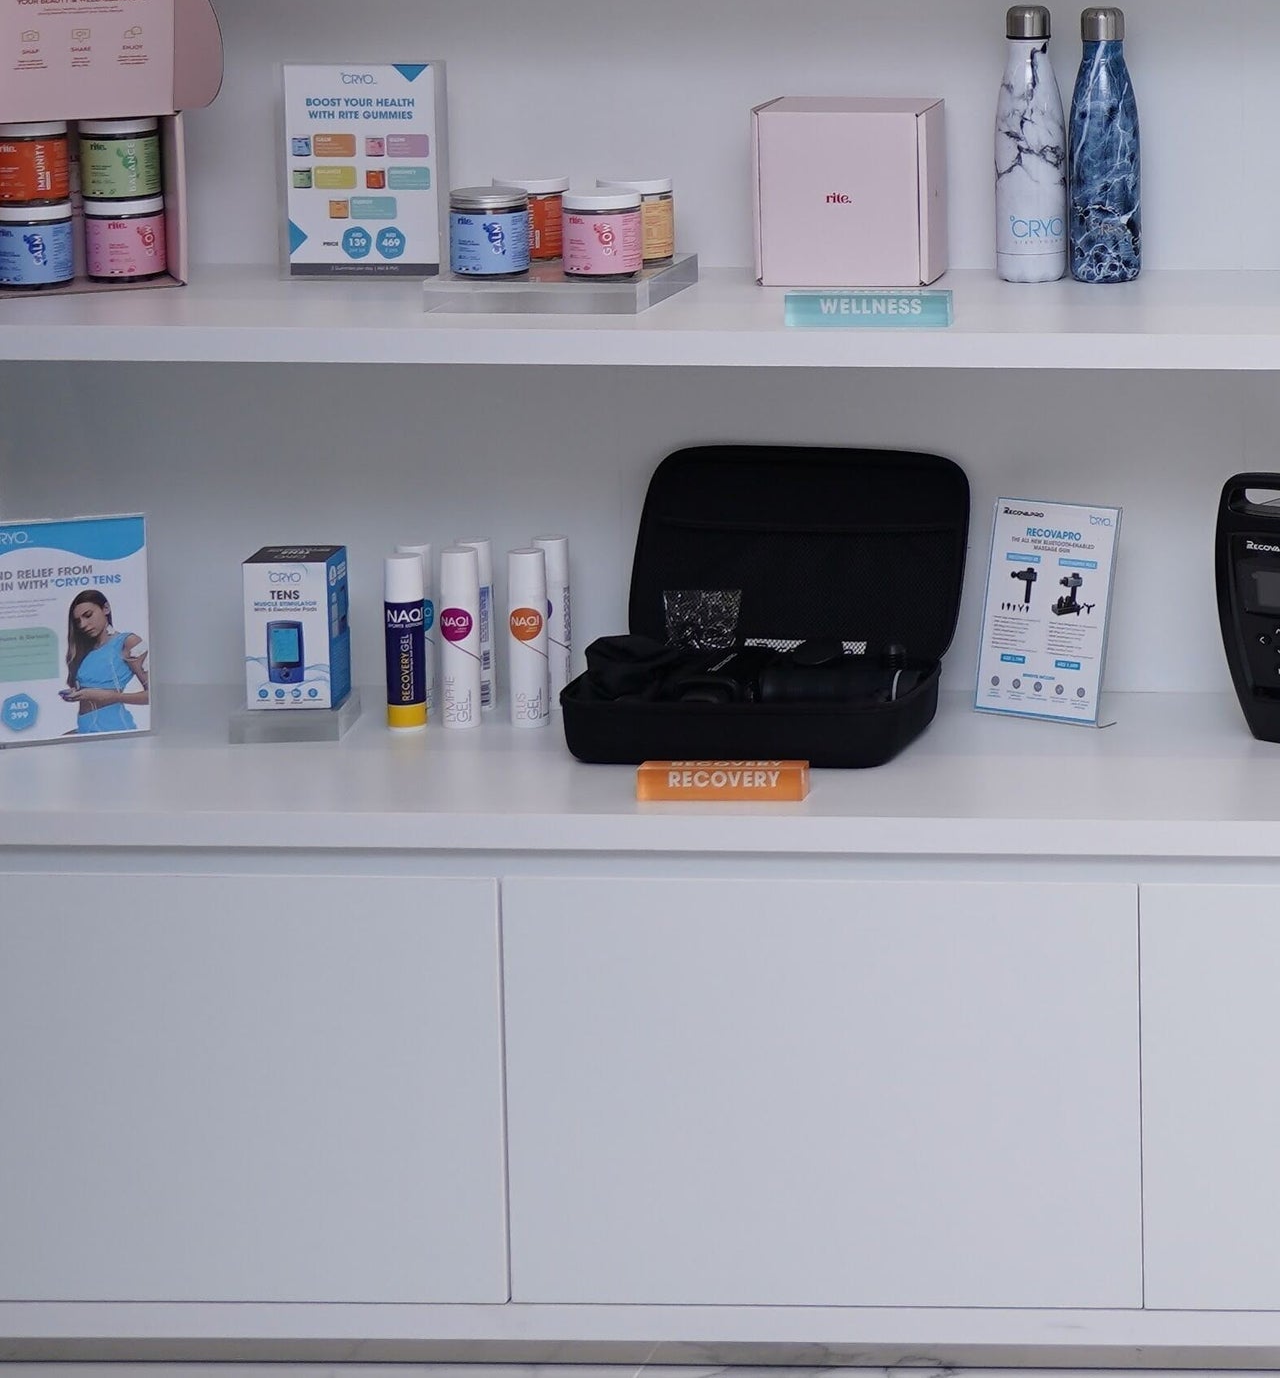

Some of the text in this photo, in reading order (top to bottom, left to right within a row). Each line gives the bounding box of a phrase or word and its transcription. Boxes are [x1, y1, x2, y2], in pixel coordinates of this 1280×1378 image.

[306, 98, 414, 107] BOOST YOUR HEALTH
[309, 111, 412, 119] WITH RITE GUMMIES
[827, 193, 852, 203] rite.
[349, 238, 366, 246] 139
[382, 238, 400, 246] 469
[493, 224, 502, 254] CALM
[603, 223, 612, 255] GLOW
[820, 299, 921, 314] WELLNESS
[1027, 528, 1081, 541] RECOVAPRO
[17, 565, 92, 579] RELIEF FROM
[18, 581, 48, 590] WITH
[94, 574, 121, 584] TENS
[270, 591, 299, 600] TENS
[387, 608, 423, 622] NAQI
[442, 616, 468, 627] NAQI
[511, 616, 540, 627] NAQI
[668, 771, 779, 787] RECOVERY
